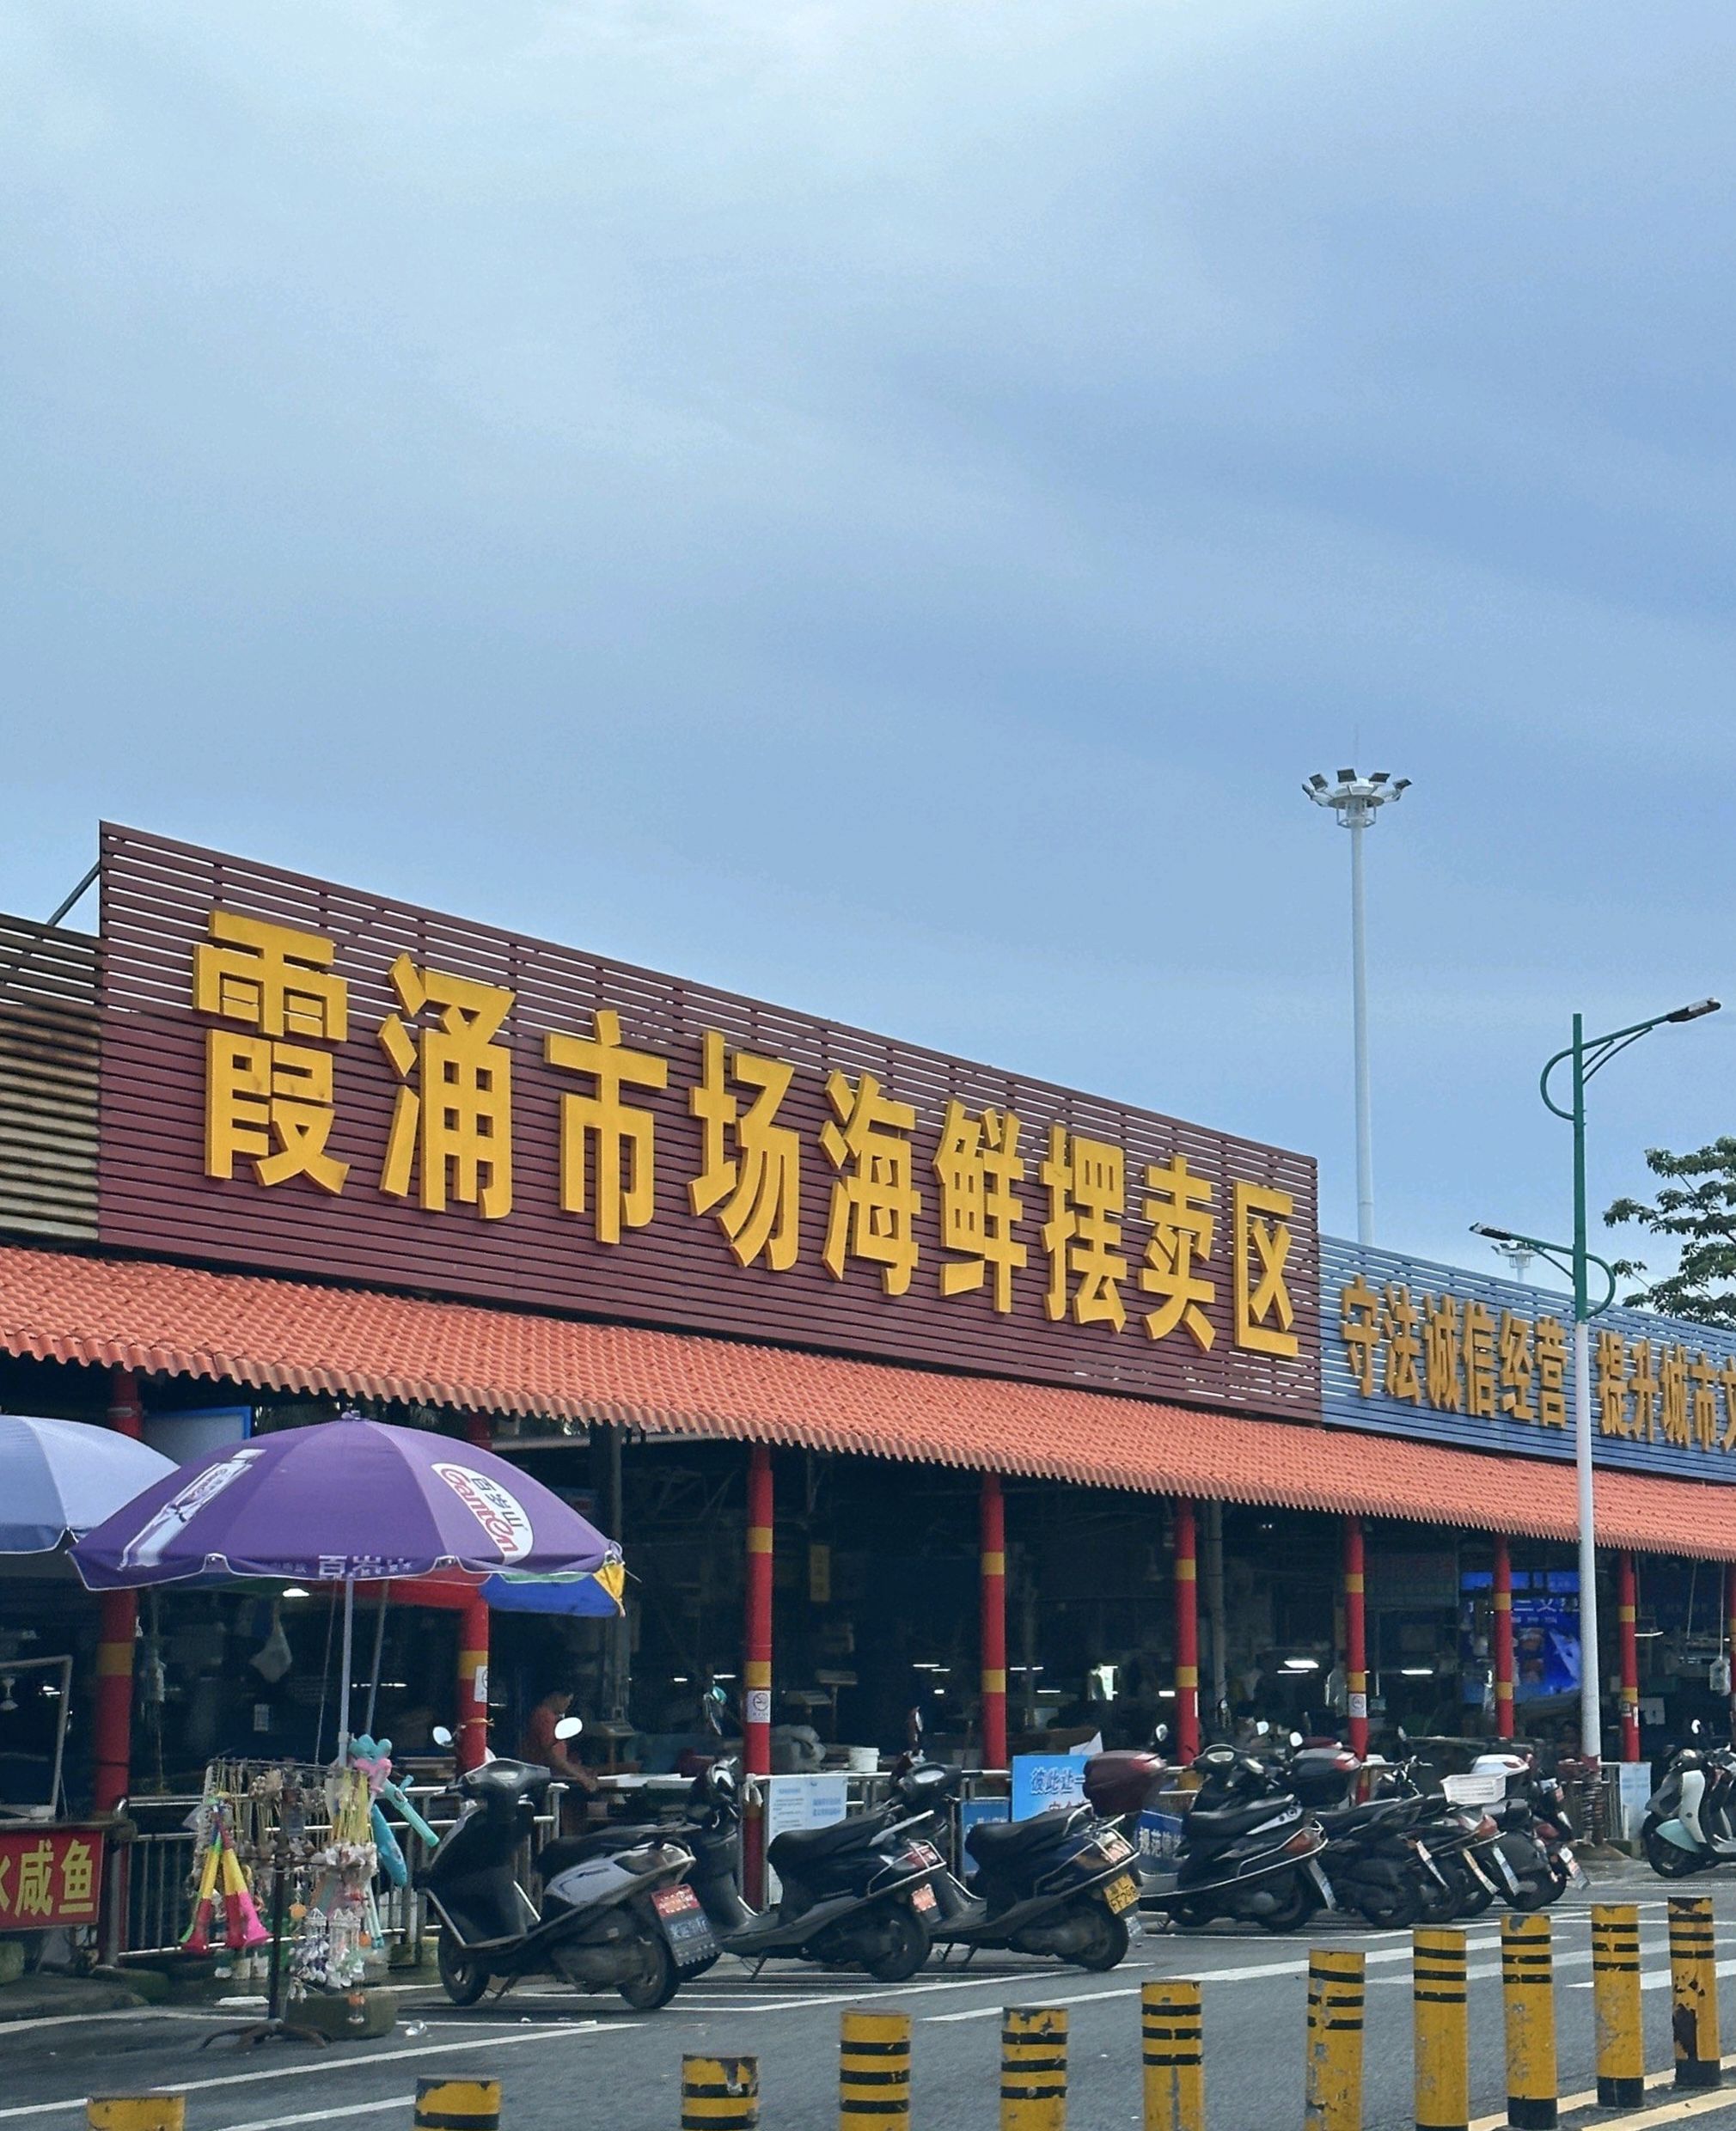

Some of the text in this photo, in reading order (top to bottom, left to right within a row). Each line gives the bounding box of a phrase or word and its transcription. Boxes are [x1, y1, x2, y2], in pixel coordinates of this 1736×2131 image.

[193, 909, 1299, 1358] 霞涌市场海鲜摆卖区
[1341, 1273, 1568, 1430] 守法诚信经营
[471, 1478, 524, 1527] 百岁山
